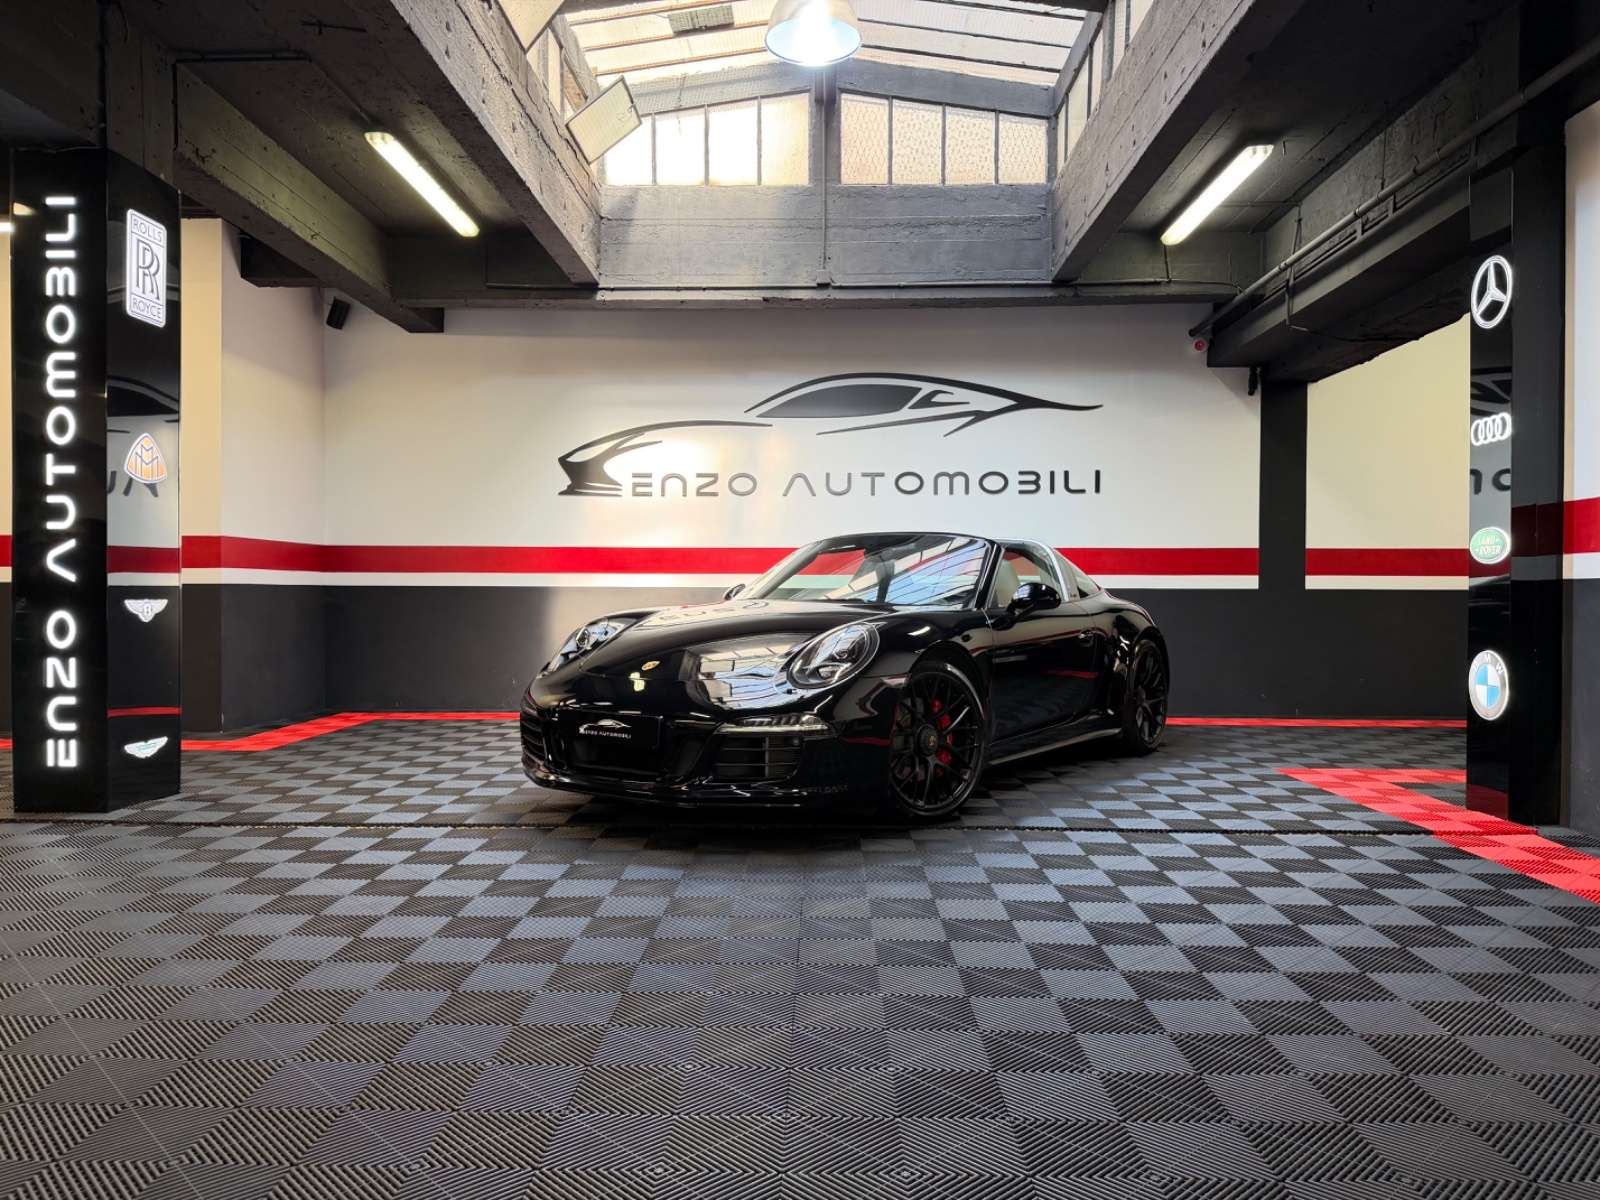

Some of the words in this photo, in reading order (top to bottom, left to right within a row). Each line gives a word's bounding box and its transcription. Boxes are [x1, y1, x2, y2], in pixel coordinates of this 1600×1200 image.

[133, 217, 162, 243] ROLLS
[132, 297, 161, 319] ROYCE
[45, 195, 77, 583] AUTOMOBILI
[631, 472, 758, 497] ENZO
[782, 469, 1101, 496] AUTOMOBILI
[45, 609, 78, 768] ENZO
